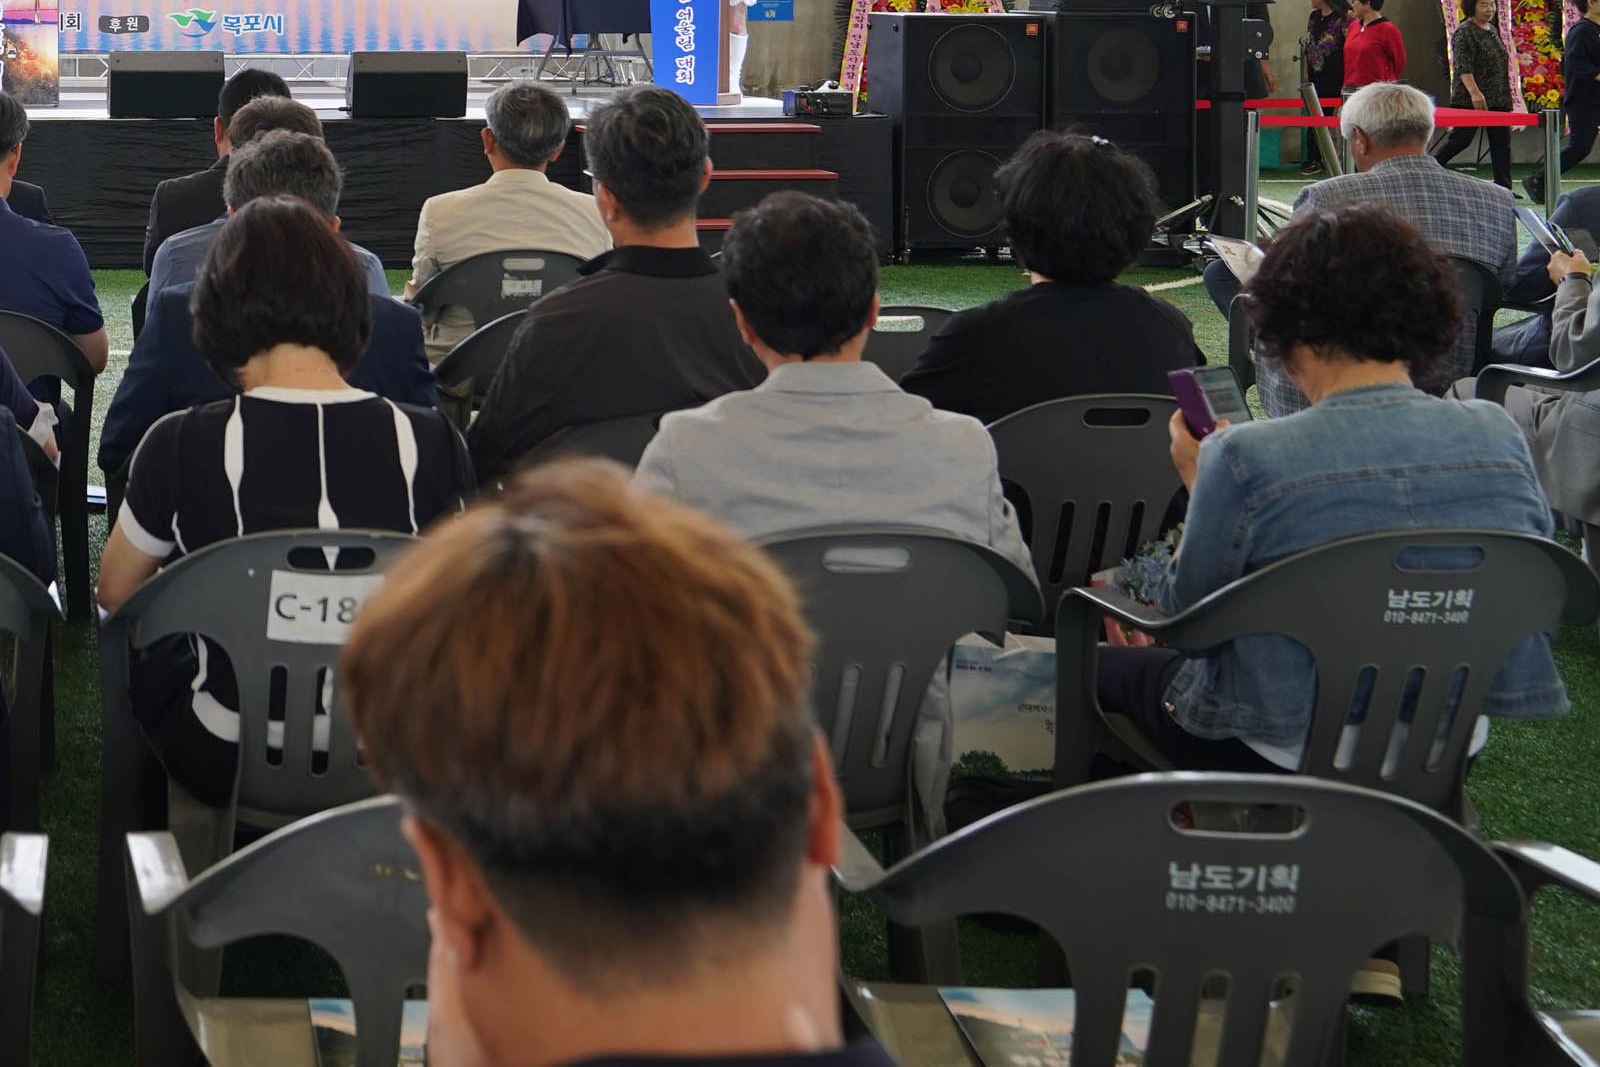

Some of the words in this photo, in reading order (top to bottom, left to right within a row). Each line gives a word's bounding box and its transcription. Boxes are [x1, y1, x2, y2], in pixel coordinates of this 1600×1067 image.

[222, 14, 284, 35] 목포시
[674, 6, 697, 52] 어울림
[675, 55, 696, 85] 대회
[1388, 588, 1475, 609] 남도기획
[1383, 609, 1470, 624] 010-8471-3400
[1168, 860, 1300, 893] 남도기획
[1165, 891, 1297, 913] 010-8471-3400
